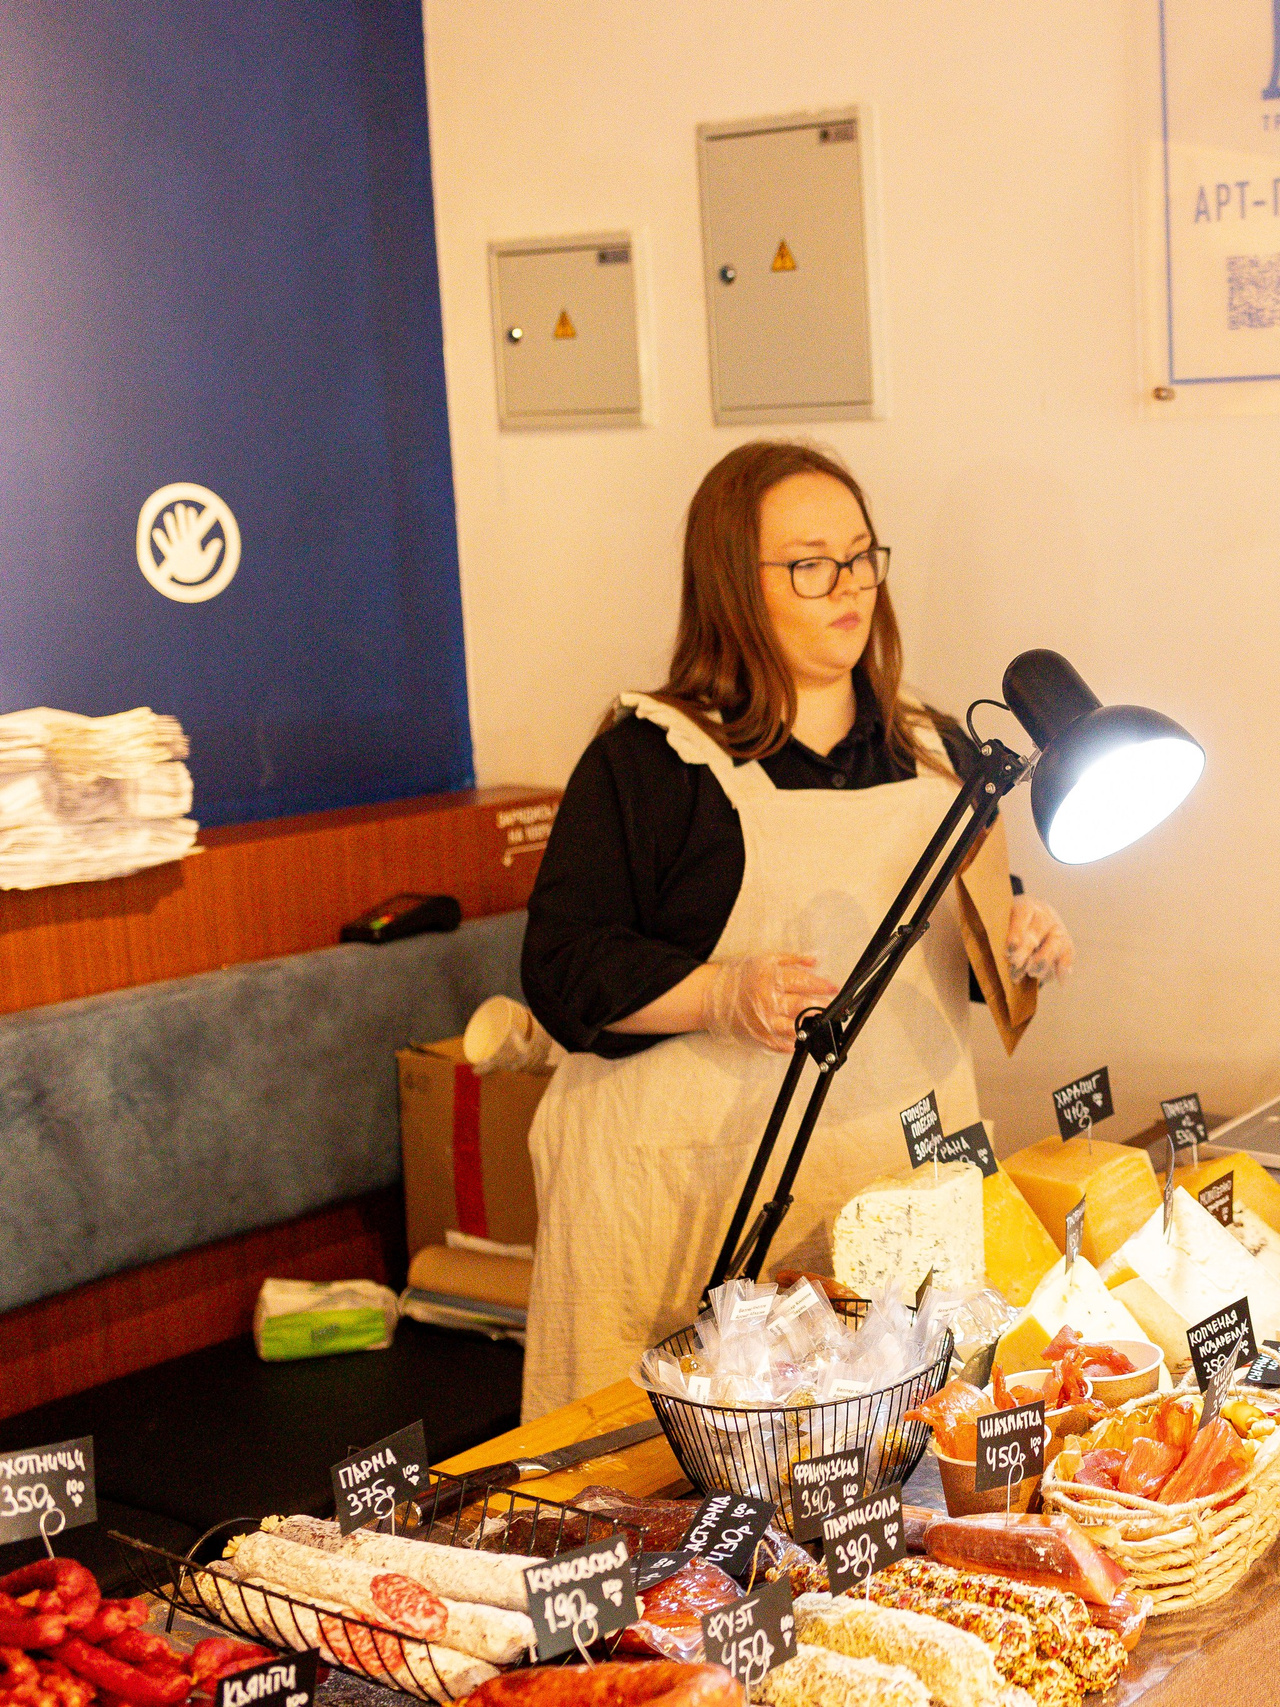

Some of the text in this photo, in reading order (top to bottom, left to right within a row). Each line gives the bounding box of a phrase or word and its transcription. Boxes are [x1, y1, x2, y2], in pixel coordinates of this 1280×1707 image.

[1189, 1310, 1238, 1347] КОПЧЕНАЯ
[980, 1410, 1042, 1439] ШАХМАТКА
[0, 1449, 86, 1480] ХОТНИЧЬИ
[338, 1448, 398, 1489] ПАРМА
[707, 1598, 760, 1643] ФУЭТ
